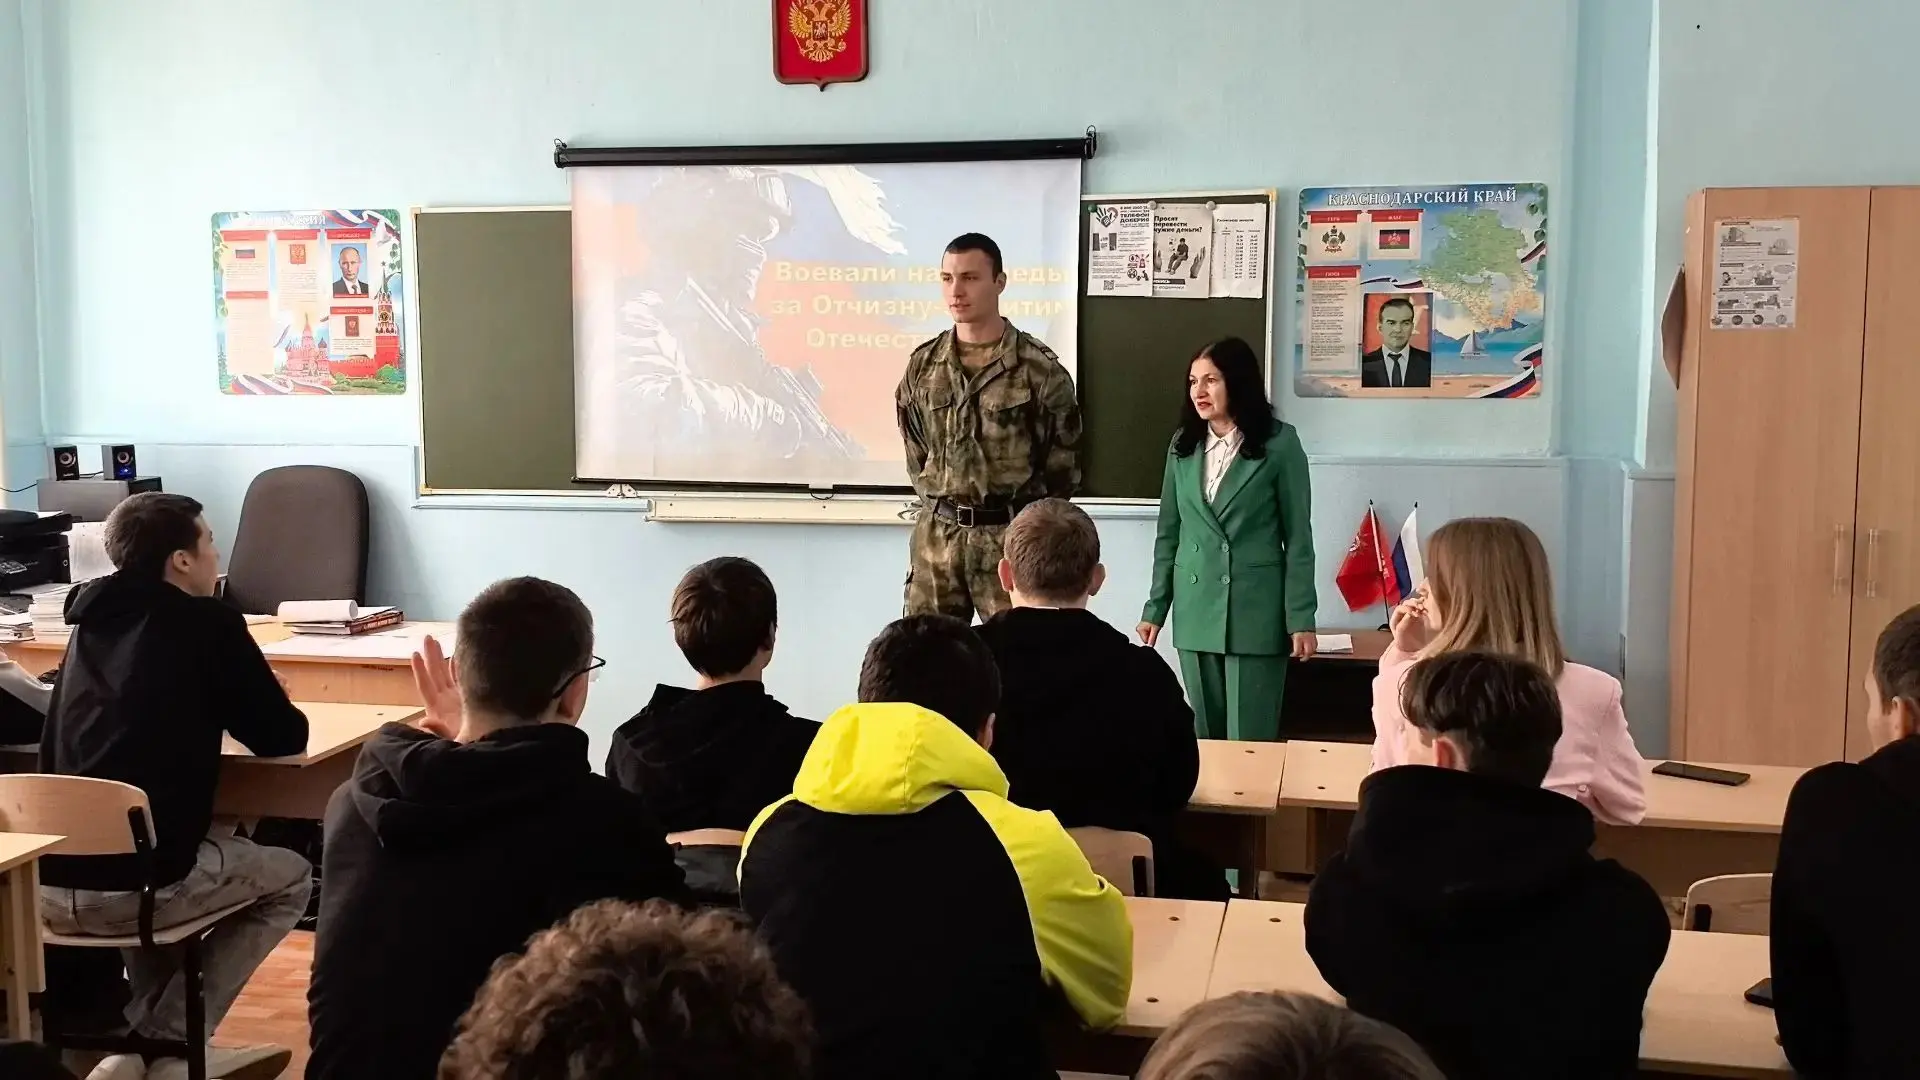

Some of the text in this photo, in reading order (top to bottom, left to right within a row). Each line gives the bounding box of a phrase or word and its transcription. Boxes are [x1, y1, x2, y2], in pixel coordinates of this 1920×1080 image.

[1328, 187, 1517, 207] КРАСНОДАРСКИЙ КРАЙ
[1154, 215, 1178, 223] Просят
[775, 261, 897, 283] Воевали
[770, 299, 802, 315] за
